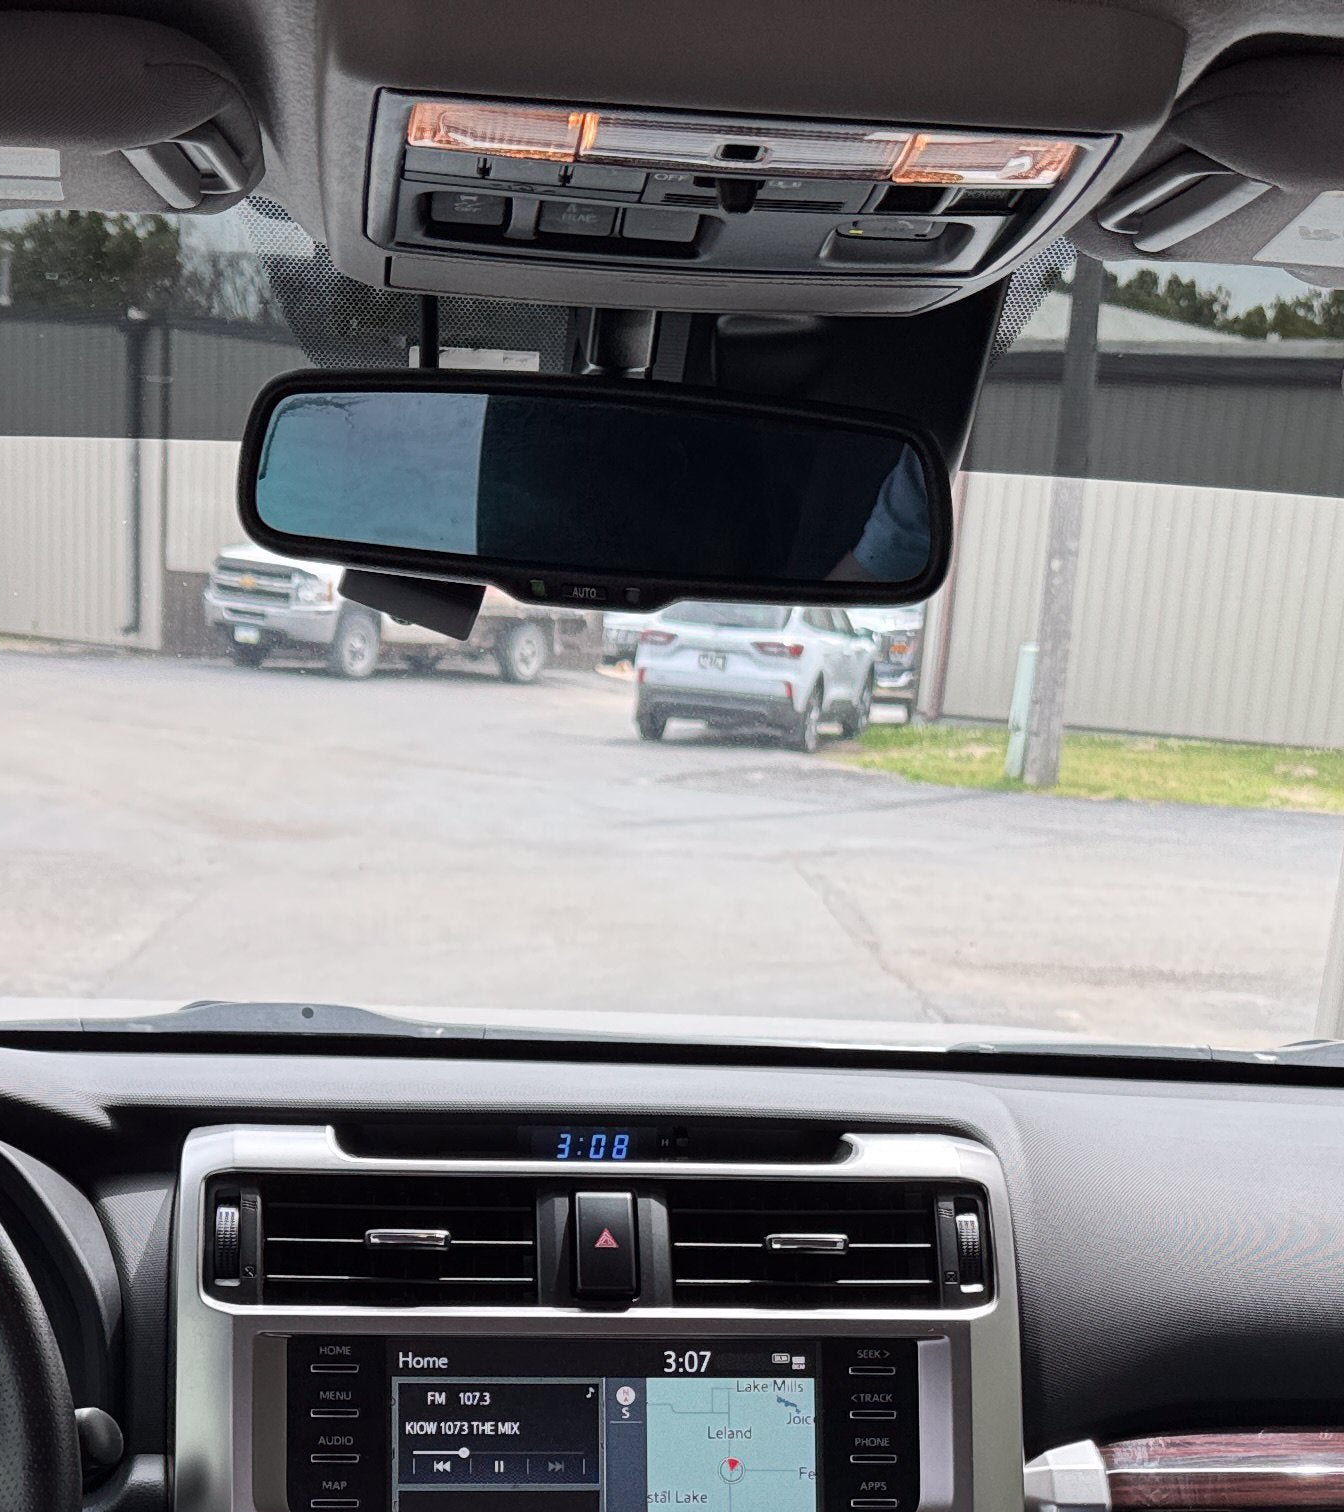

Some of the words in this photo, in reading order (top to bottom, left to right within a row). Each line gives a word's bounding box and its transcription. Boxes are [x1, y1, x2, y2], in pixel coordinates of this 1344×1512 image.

[572, 586, 597, 598] AUTO
[557, 1133, 630, 1160] 3:08
[319, 1346, 352, 1356] HOME
[857, 1349, 881, 1359] SEEK
[399, 1353, 449, 1370] Home
[663, 1351, 712, 1373] 3:07
[736, 1379, 769, 1393] Lake
[772, 1379, 804, 1393] Mills
[319, 1391, 352, 1401] MENU
[427, 1391, 446, 1405] FM
[458, 1391, 491, 1406] 107.3
[860, 1393, 893, 1403] TRACK
[621, 1406, 631, 1419] S
[405, 1421, 438, 1436] KIOW
[439, 1421, 470, 1436] 1073
[471, 1421, 496, 1436] THE
[497, 1421, 520, 1436] MIX
[707, 1425, 753, 1440] Leland
[318, 1435, 354, 1446] AUDIO
[854, 1437, 890, 1447] PHONE
[322, 1481, 347, 1491] MAP
[859, 1481, 887, 1491] APPS
[675, 1490, 708, 1504] Lake
